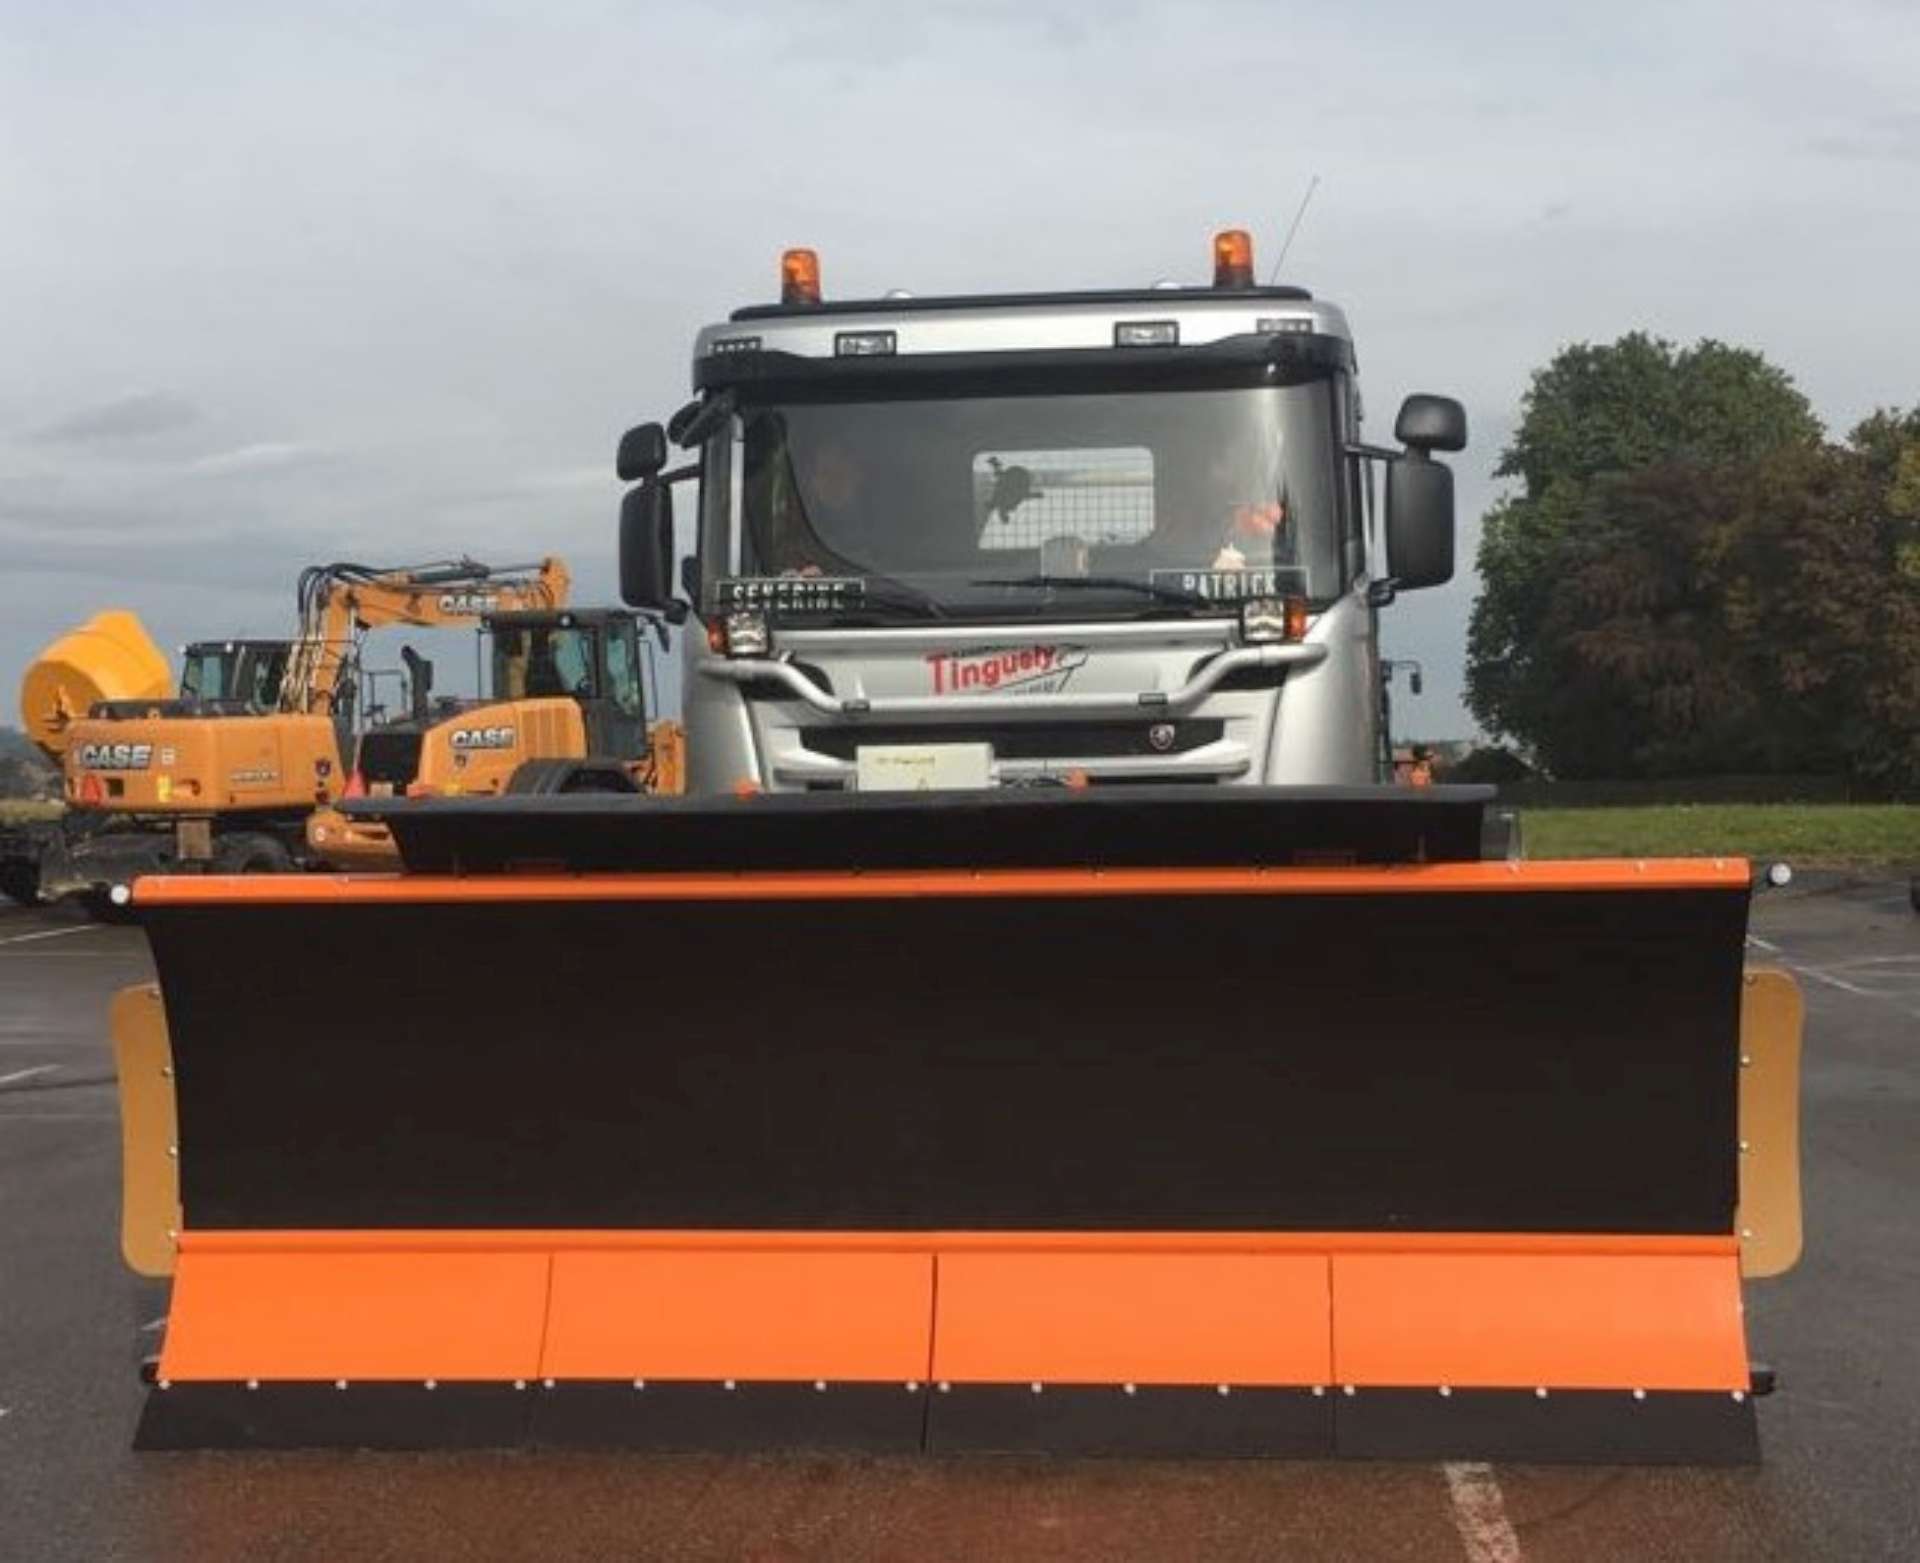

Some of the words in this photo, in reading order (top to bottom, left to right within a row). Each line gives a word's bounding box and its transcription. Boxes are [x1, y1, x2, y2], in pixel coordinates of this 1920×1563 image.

[1182, 572, 1276, 599] PATRICK
[439, 595, 496, 614] CASE
[925, 646, 1057, 695] Tinguely
[451, 727, 515, 749] CASE
[82, 745, 151, 769] CASE
